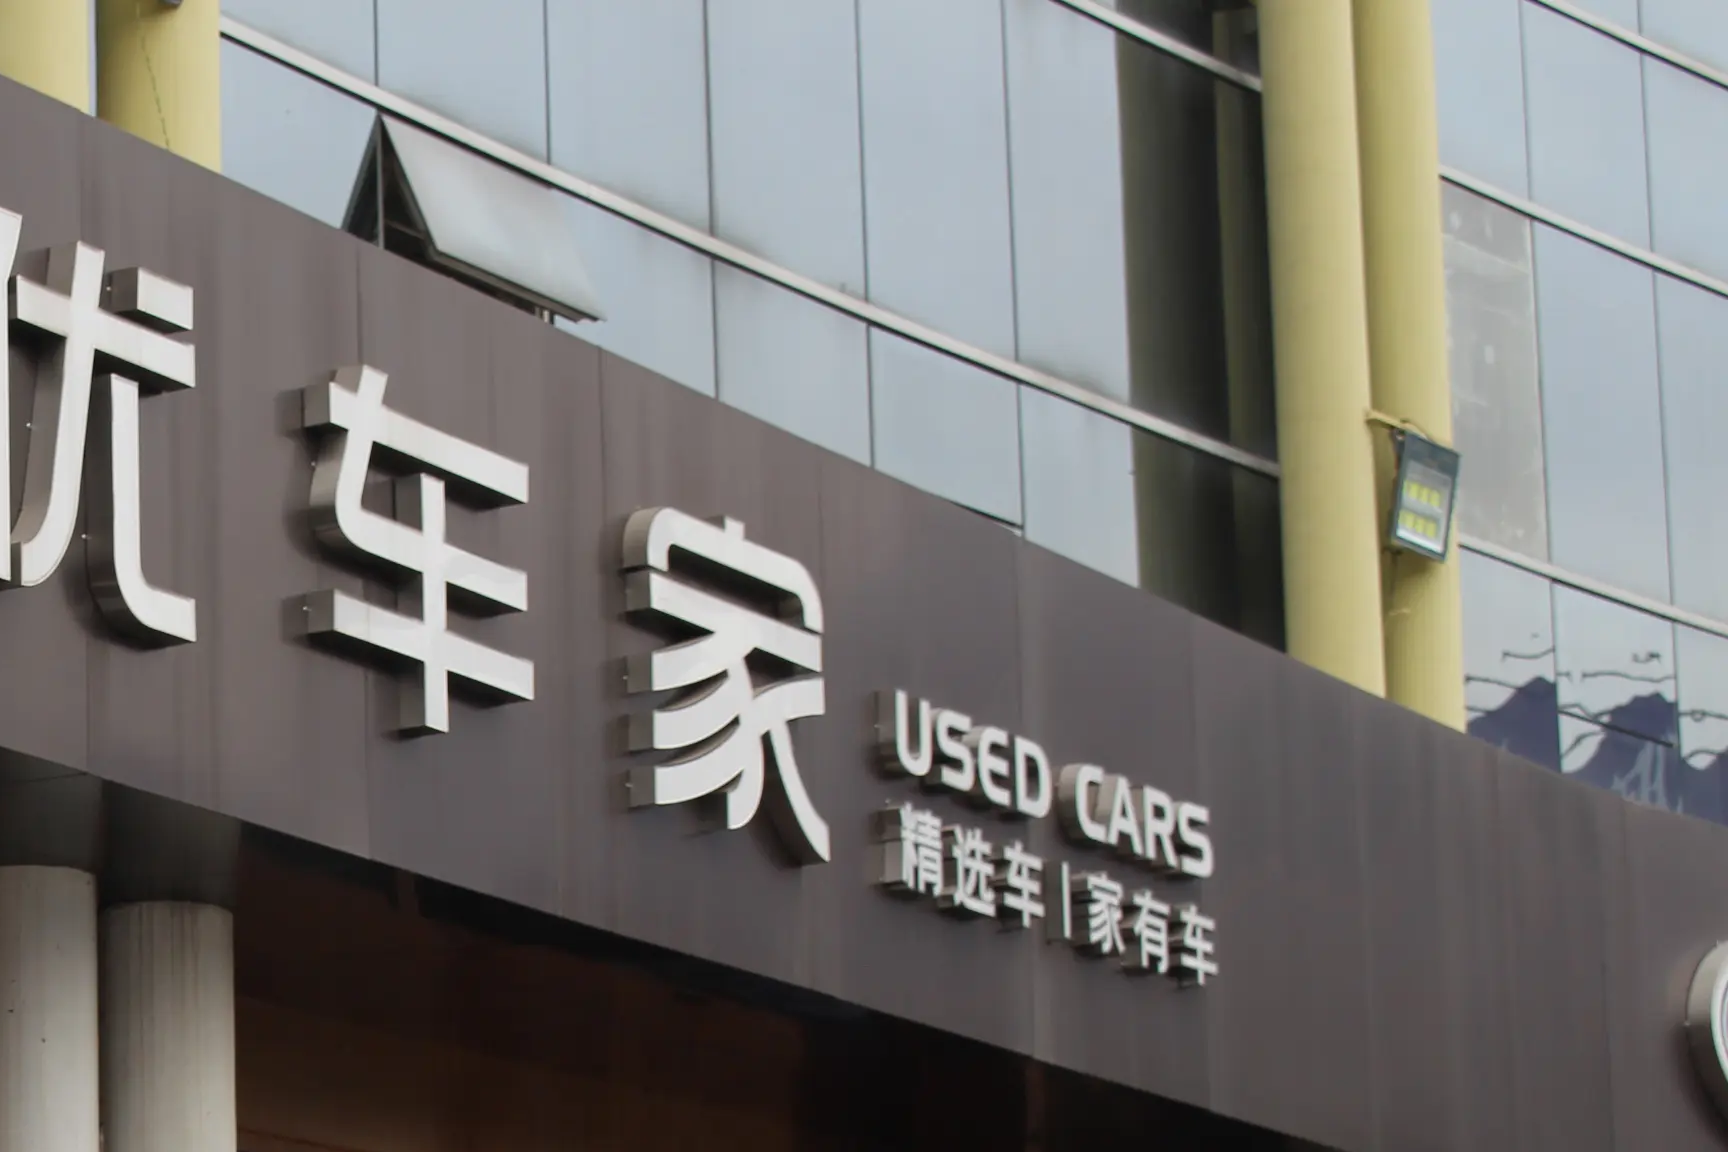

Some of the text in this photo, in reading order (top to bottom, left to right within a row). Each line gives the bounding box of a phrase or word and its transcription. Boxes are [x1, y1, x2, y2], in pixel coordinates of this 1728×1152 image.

[893, 689, 1214, 879] USED CARS
[899, 802, 1219, 985] 精选车 家有车
